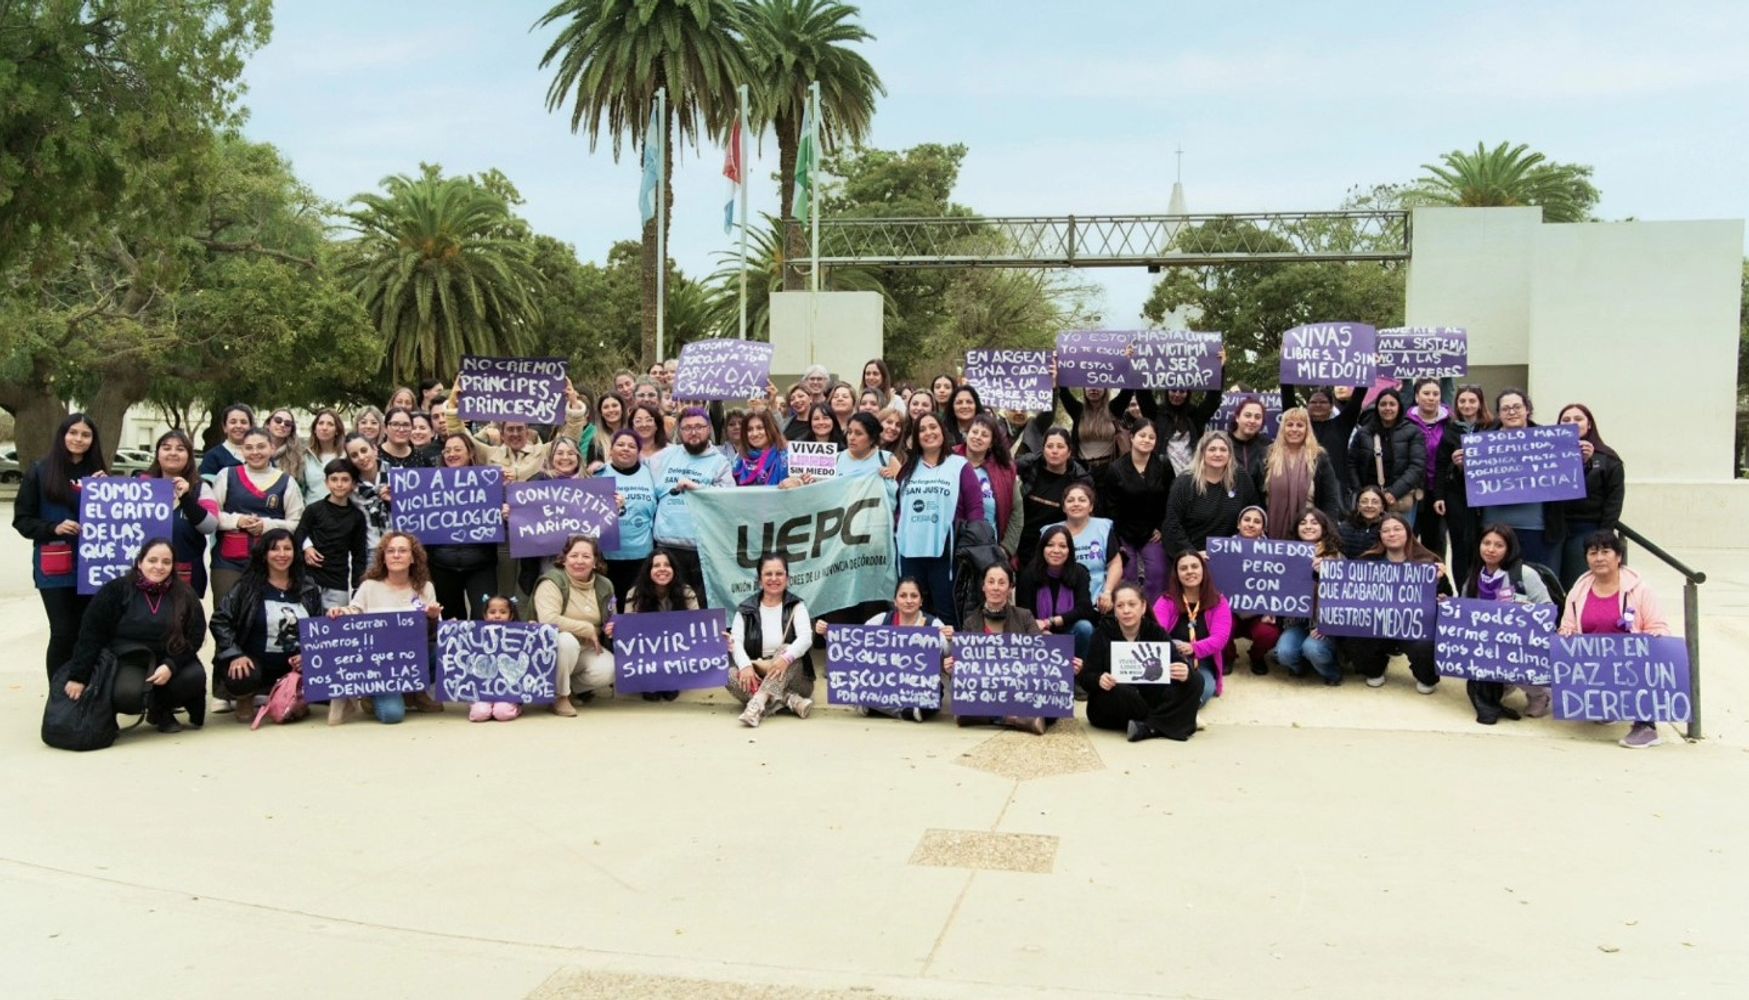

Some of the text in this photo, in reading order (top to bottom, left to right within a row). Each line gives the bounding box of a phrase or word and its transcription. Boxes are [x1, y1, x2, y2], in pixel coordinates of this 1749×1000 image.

[1062, 333, 1127, 343] YO ESTO
[1292, 326, 1352, 347] VIVAS
[1379, 337, 1466, 355] MAL SISTEMA
[967, 351, 988, 364] EN
[1138, 344, 1153, 357] LA
[1283, 346, 1376, 367] LIBRES Y SIN
[1401, 353, 1410, 364] A
[1416, 352, 1442, 364] LAS
[463, 358, 568, 381] NO CRIEMOS
[967, 364, 1048, 377] TINA CADA
[1058, 360, 1114, 371] NO ESTAS
[1131, 356, 1199, 372] VA A SER
[1393, 365, 1462, 378] MUJERES
[461, 373, 550, 400] PRINCIPES
[1019, 378, 1037, 390] UN
[1087, 371, 1126, 384] SOLA
[1142, 369, 1213, 388] JUZGADA?
[976, 388, 1021, 399] OMBRE
[462, 394, 556, 424] PRINCESAS
[1464, 435, 1482, 444] NO
[1488, 431, 1525, 441] SOLO
[792, 443, 835, 455] VIVAS
[1465, 447, 1481, 457] EL
[790, 466, 835, 475] SIN MIEDO
[394, 469, 478, 493] NO A LA
[1476, 468, 1579, 494] JUSTICIA!
[86, 482, 153, 502] SOMOS
[396, 488, 487, 513] VIOLENCIA
[625, 494, 651, 502] JUSTO
[923, 486, 951, 497] JUSTO
[85, 503, 106, 519] EL
[111, 502, 169, 520] GRITO
[515, 485, 616, 526] CONVERTITE
[543, 504, 565, 516] EN
[396, 508, 502, 533] PSICOLOGICA
[519, 516, 600, 538] MARIPOSA
[82, 522, 145, 541] DE LAS
[736, 497, 881, 569] UEPC
[80, 542, 116, 560] QUE
[1210, 540, 1315, 558] SIN MIEDOS
[1242, 559, 1286, 574] PERO
[1320, 561, 1436, 583] NOS QUITARON TANTO
[1245, 577, 1280, 591] CON
[1318, 582, 1422, 603] QUE ACABARON CON
[1320, 607, 1371, 626] NUESTROS
[1440, 601, 1526, 627] Si podés
[309, 613, 415, 638] No cierran los
[1011, 633, 1046, 647] NOS
[1438, 625, 1550, 649] verme con los
[828, 643, 854, 662] OS
[855, 648, 887, 666] QUE
[961, 646, 1070, 667] QUEREMOS,
[1437, 642, 1551, 669] ojos del alma
[1560, 637, 1650, 657] VIVIR EN
[311, 648, 416, 669] O será que no
[623, 654, 729, 678] SIN MIEDOS
[308, 664, 421, 685] nos toman LAS
[954, 661, 1062, 678] POR LAS QUE YA
[1436, 659, 1525, 681] vos también
[1553, 660, 1676, 689] PAZ ES UN
[953, 677, 977, 690] NO
[1033, 678, 1041, 691] Y
[1043, 679, 1071, 693] POR
[953, 690, 977, 703] LAS
[980, 690, 1008, 703] QUE
[1562, 688, 1691, 721] DERECHO
